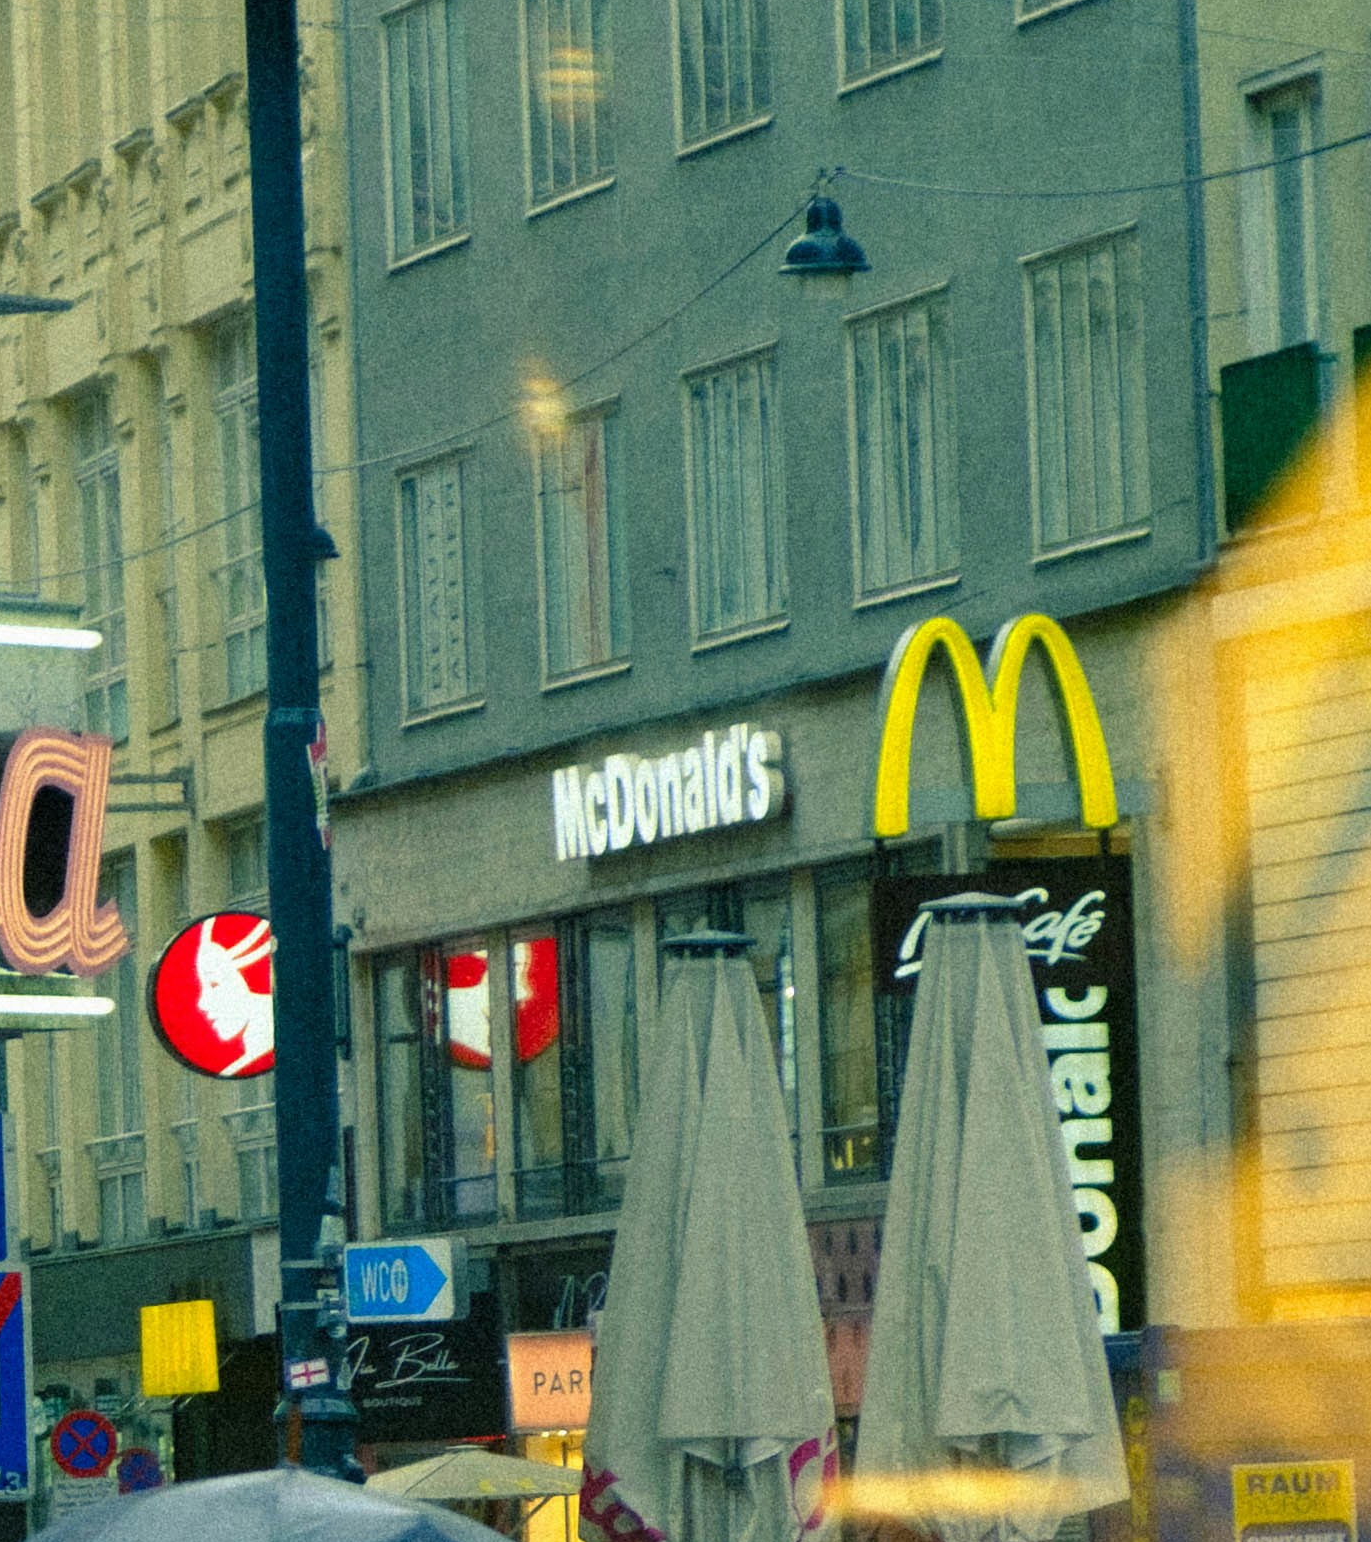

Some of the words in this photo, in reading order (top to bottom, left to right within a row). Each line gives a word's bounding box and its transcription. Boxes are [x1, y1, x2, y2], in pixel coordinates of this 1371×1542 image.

[553, 722, 783, 862] McDonald's
[533, 1369, 593, 1396] PAR
[1246, 1470, 1340, 1496] RAUM
